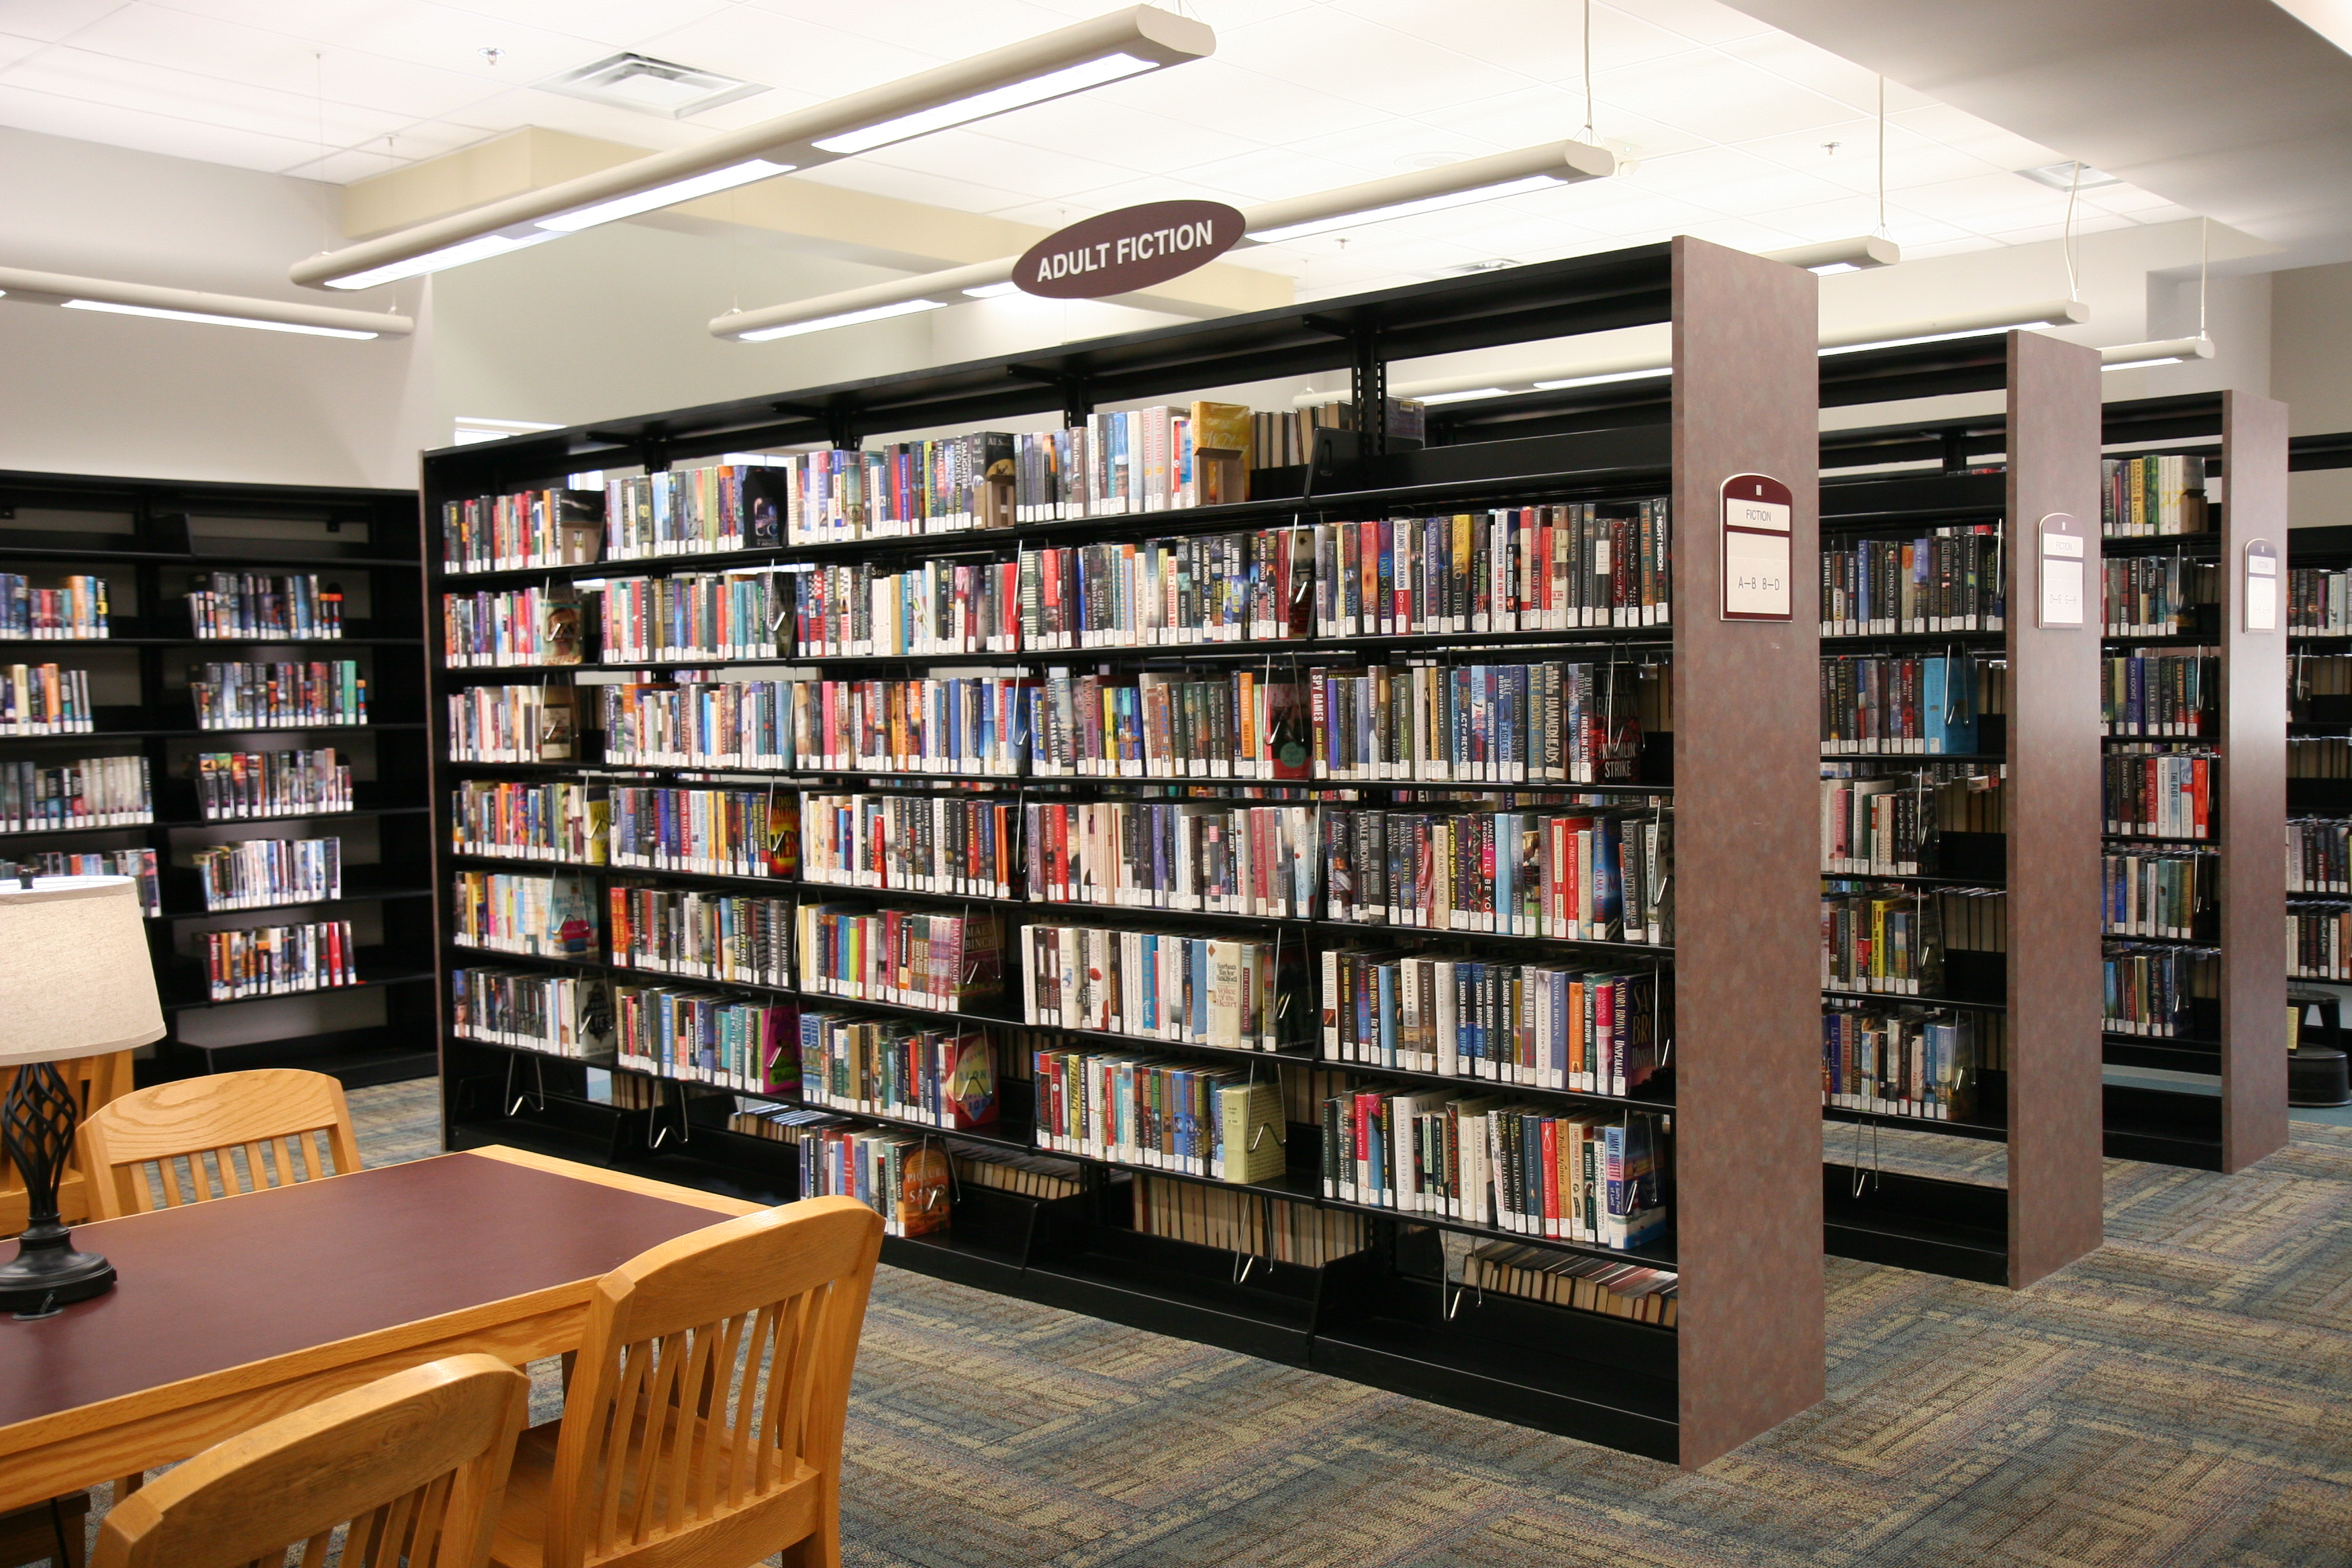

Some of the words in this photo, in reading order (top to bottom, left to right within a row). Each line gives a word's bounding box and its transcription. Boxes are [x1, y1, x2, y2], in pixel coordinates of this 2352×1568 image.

[1037, 242, 1110, 283] ADULT
[1117, 219, 1212, 264] FICTION
[1746, 509, 1771, 522] FICTION
[1397, 524, 1406, 550] SUZANNE
[2055, 541, 2072, 550] FICTION
[1193, 563, 1201, 581] BOND
[1380, 557, 1388, 580] DARK
[1397, 552, 1406, 589] BROCKMANN
[1738, 576, 1757, 590] A-B
[1762, 578, 1780, 591] B-D
[1380, 588, 1389, 618] NIGHT
[1312, 675, 1323, 691] SPY
[1530, 667, 1542, 691] DALE
[1083, 681, 1092, 719] WARLORD
[1314, 693, 1324, 721] GAMES
[1530, 695, 1541, 730] BROWN
[1545, 697, 1559, 763] HAMMERHEADS
[1581, 716, 1589, 745] KREMLIN
[1604, 759, 1632, 778] STRIKE
[1359, 817, 1369, 838] DALE
[1622, 826, 1634, 855] BEFORE
[1360, 840, 1369, 871] BROWN
[1485, 879, 1491, 891] BE
[1596, 869, 1604, 890] ALMA
[1626, 874, 1636, 897] AFTER
[952, 954, 961, 984] BINCHY
[1324, 954, 1335, 981] SANDRA
[1217, 987, 1237, 995] Voice
[1324, 983, 1335, 1007] BROWN
[1406, 971, 1414, 997] SANDRA
[1524, 970, 1534, 998] SANDRA
[1615, 983, 1626, 1007] SANDRA
[1217, 999, 1238, 1008] Heart
[1524, 1001, 1534, 1028] BROWN
[1615, 1010, 1624, 1036] BROWN
[1069, 1061, 1079, 1112] FLASHBACK
[1608, 1132, 1620, 1152] JIMMY
[1610, 1155, 1622, 1178] BUFFETT
